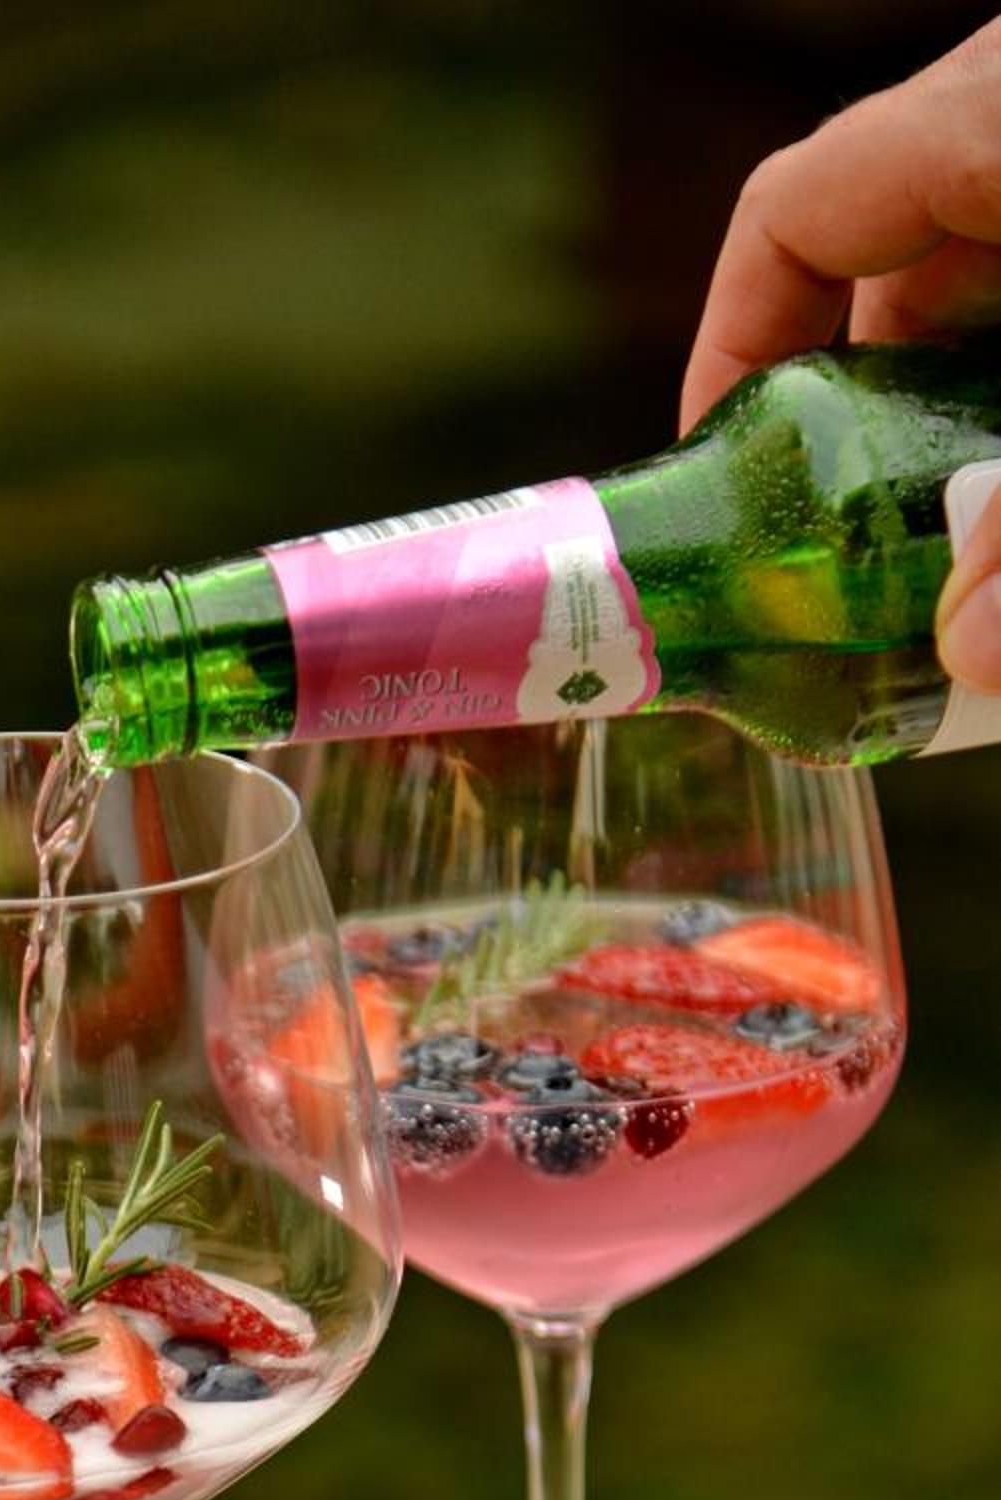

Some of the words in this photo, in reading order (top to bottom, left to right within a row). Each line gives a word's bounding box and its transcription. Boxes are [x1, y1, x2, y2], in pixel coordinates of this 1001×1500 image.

[359, 667, 468, 702] TONIC
[320, 703, 400, 731] PINK
[413, 702, 433, 725] &
[445, 692, 503, 718] GIN
